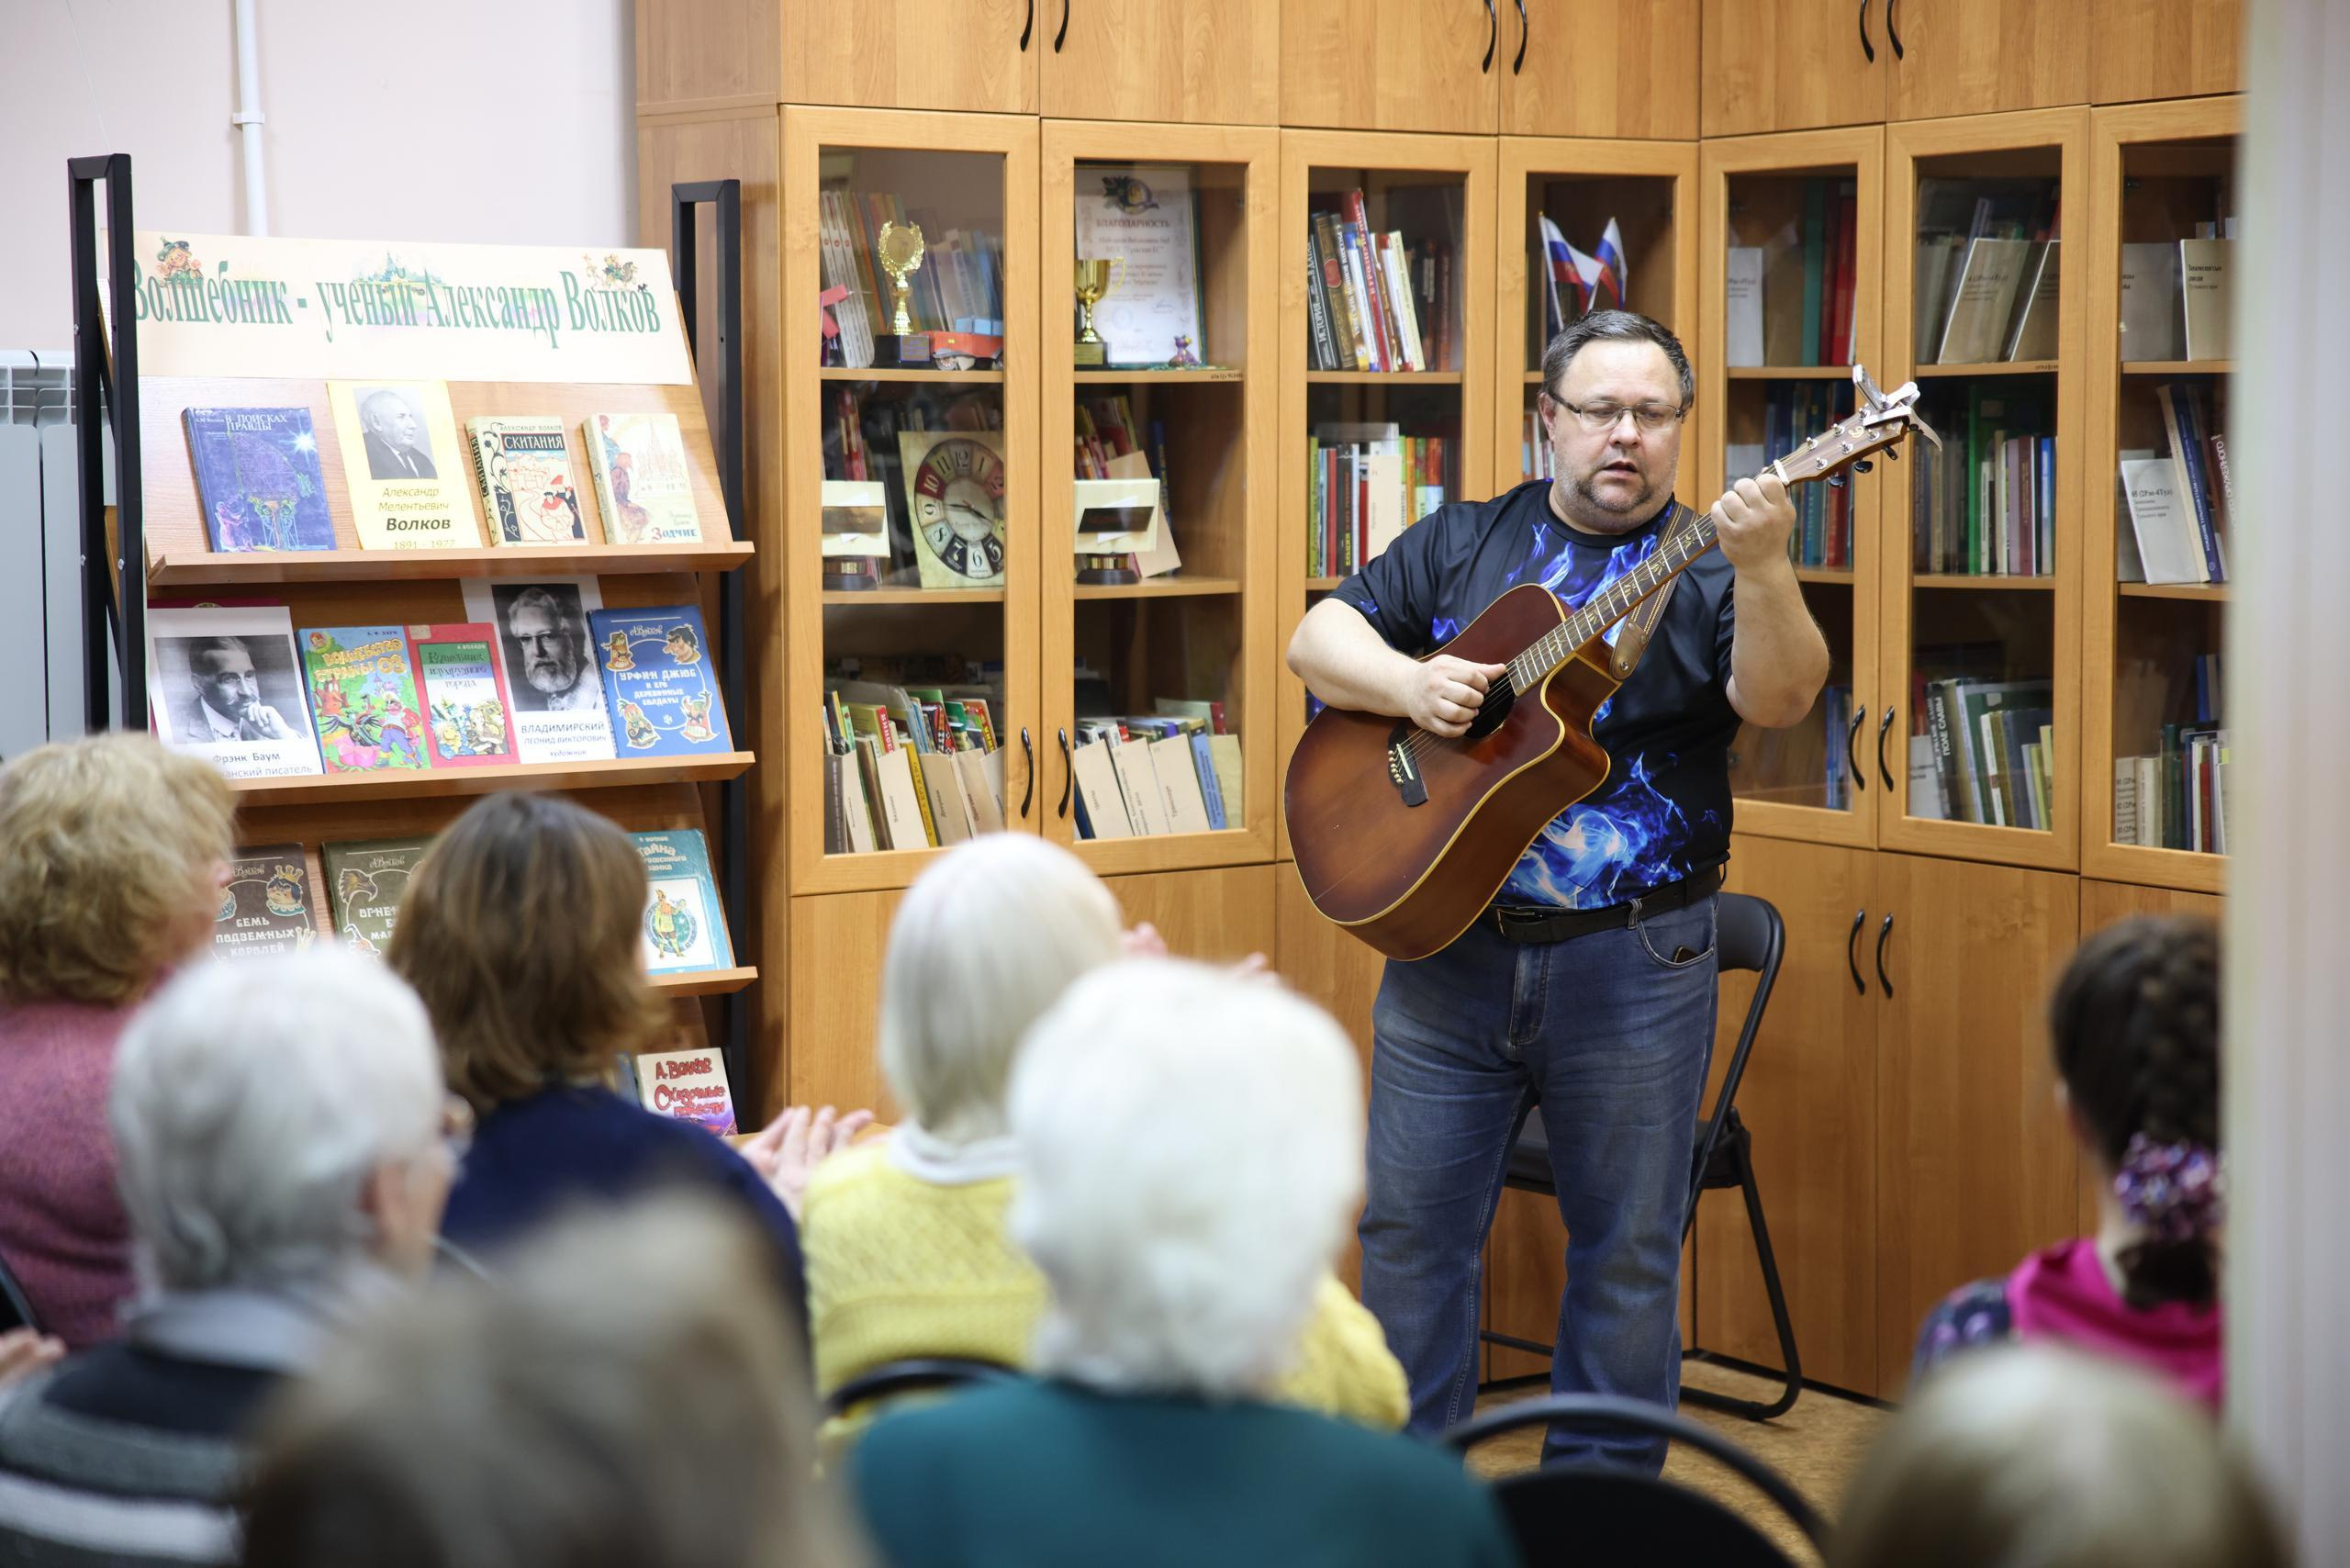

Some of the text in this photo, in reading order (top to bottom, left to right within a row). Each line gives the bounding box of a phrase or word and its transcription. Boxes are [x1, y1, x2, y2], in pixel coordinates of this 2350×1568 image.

[134, 261, 294, 325] Волшебник
[315, 273, 420, 343] ученый
[424, 268, 560, 350] Александр
[559, 270, 662, 334] Волков
[236, 414, 287, 424] ПОИСКАХ
[227, 421, 273, 431] ПРАВДЫ
[504, 435, 564, 450] СКИТАНИЯ
[470, 437, 489, 496] СКИТАНИЯ
[382, 487, 440, 498] Александр
[378, 501, 450, 512] Мелентьевич
[386, 517, 452, 532] Волков
[394, 541, 418, 551] 1891
[431, 539, 456, 549] 1977
[952, 542, 964, 562] 7
[972, 549, 983, 568] 6
[619, 668, 697, 681] УРФИН ДЖЮС
[1933, 696, 1946, 729] СЛАВЫ
[520, 722, 606, 734] ВЛАДИМИРСКИЙ
[557, 735, 607, 744] ВИКТОРОВИЧ
[1939, 730, 1950, 756] ПОЛЕ
[212, 751, 281, 764] Фрэнк Баум
[264, 765, 313, 777] писатель
[236, 916, 270, 928] СЕМЬ
[216, 928, 296, 946] ПОДЗЕМНЫХ
[230, 942, 285, 957] КОРОЛЕЙ
